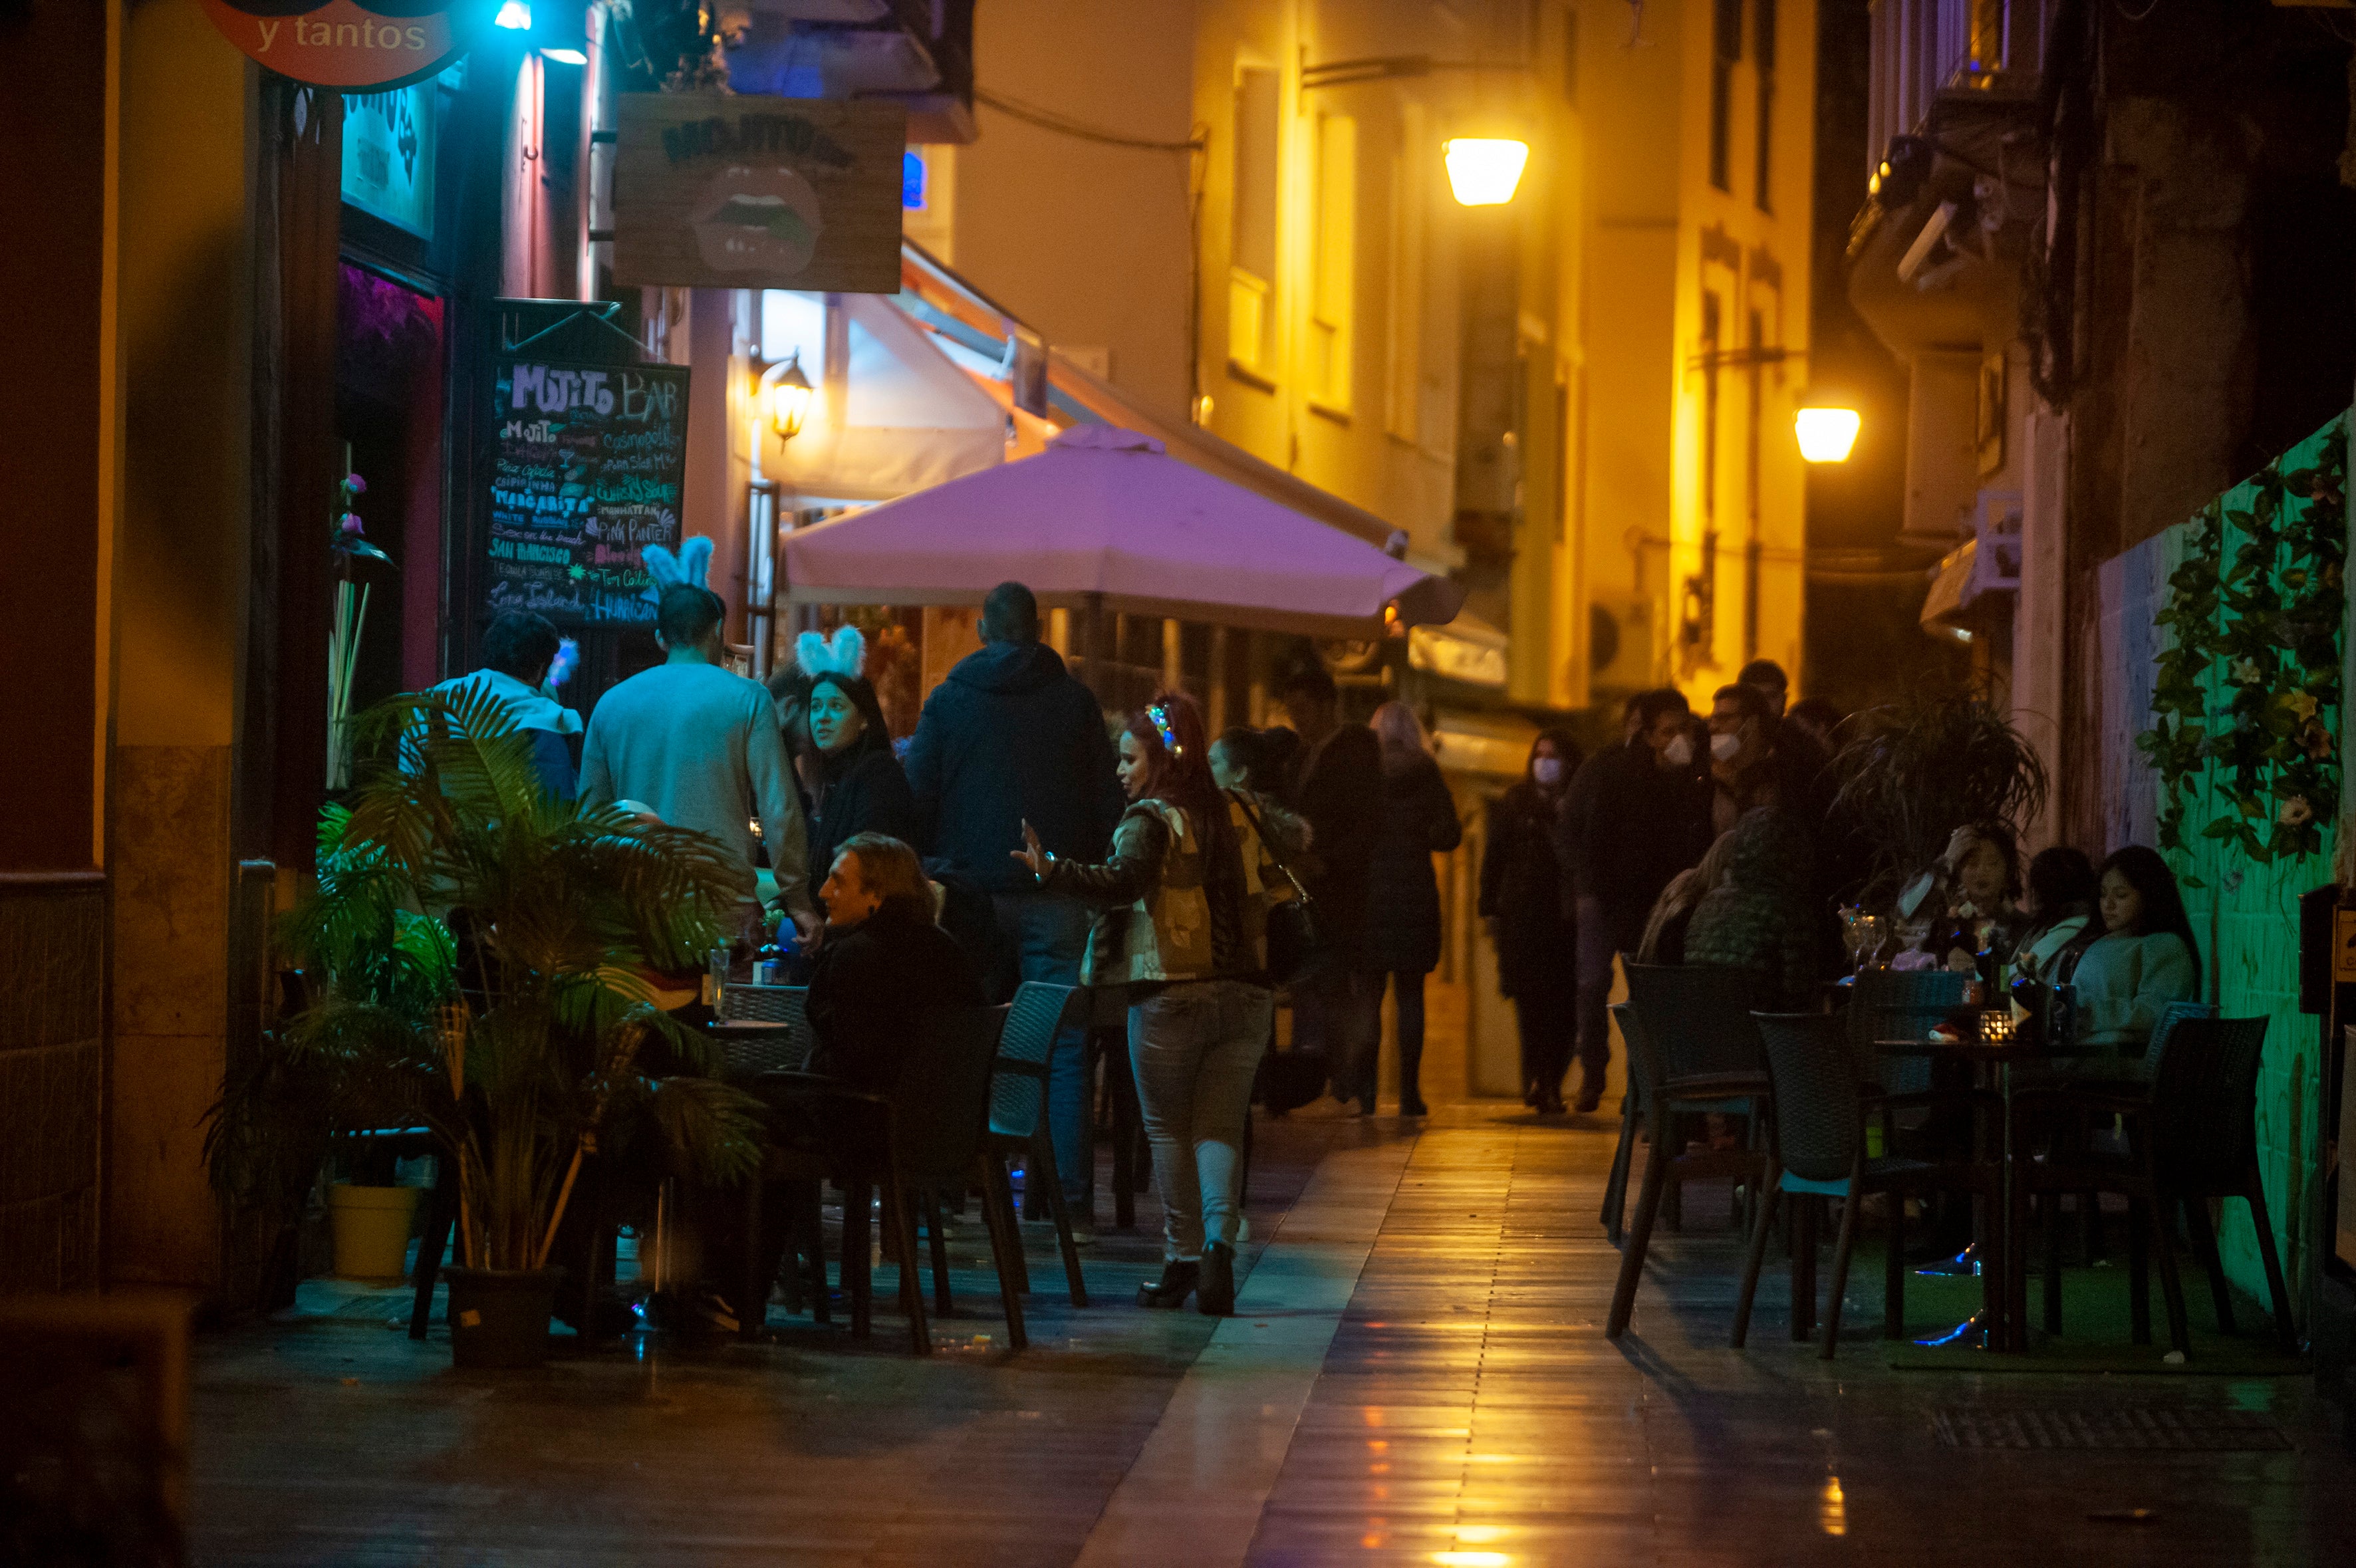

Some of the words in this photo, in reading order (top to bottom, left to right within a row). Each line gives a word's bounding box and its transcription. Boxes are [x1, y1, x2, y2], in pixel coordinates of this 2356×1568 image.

[258, 21, 280, 52] y
[296, 16, 426, 51] tantos
[617, 371, 677, 422] BAR
[601, 504, 657, 515] MANHATTAN
[628, 519, 672, 542] PANTER
[488, 537, 514, 559] SAN
[517, 542, 571, 565] FRANCISCO
[493, 561, 527, 576] TEQUILA
[598, 569, 620, 587] Tom
[487, 581, 523, 610] Long
[523, 581, 583, 611] Island
